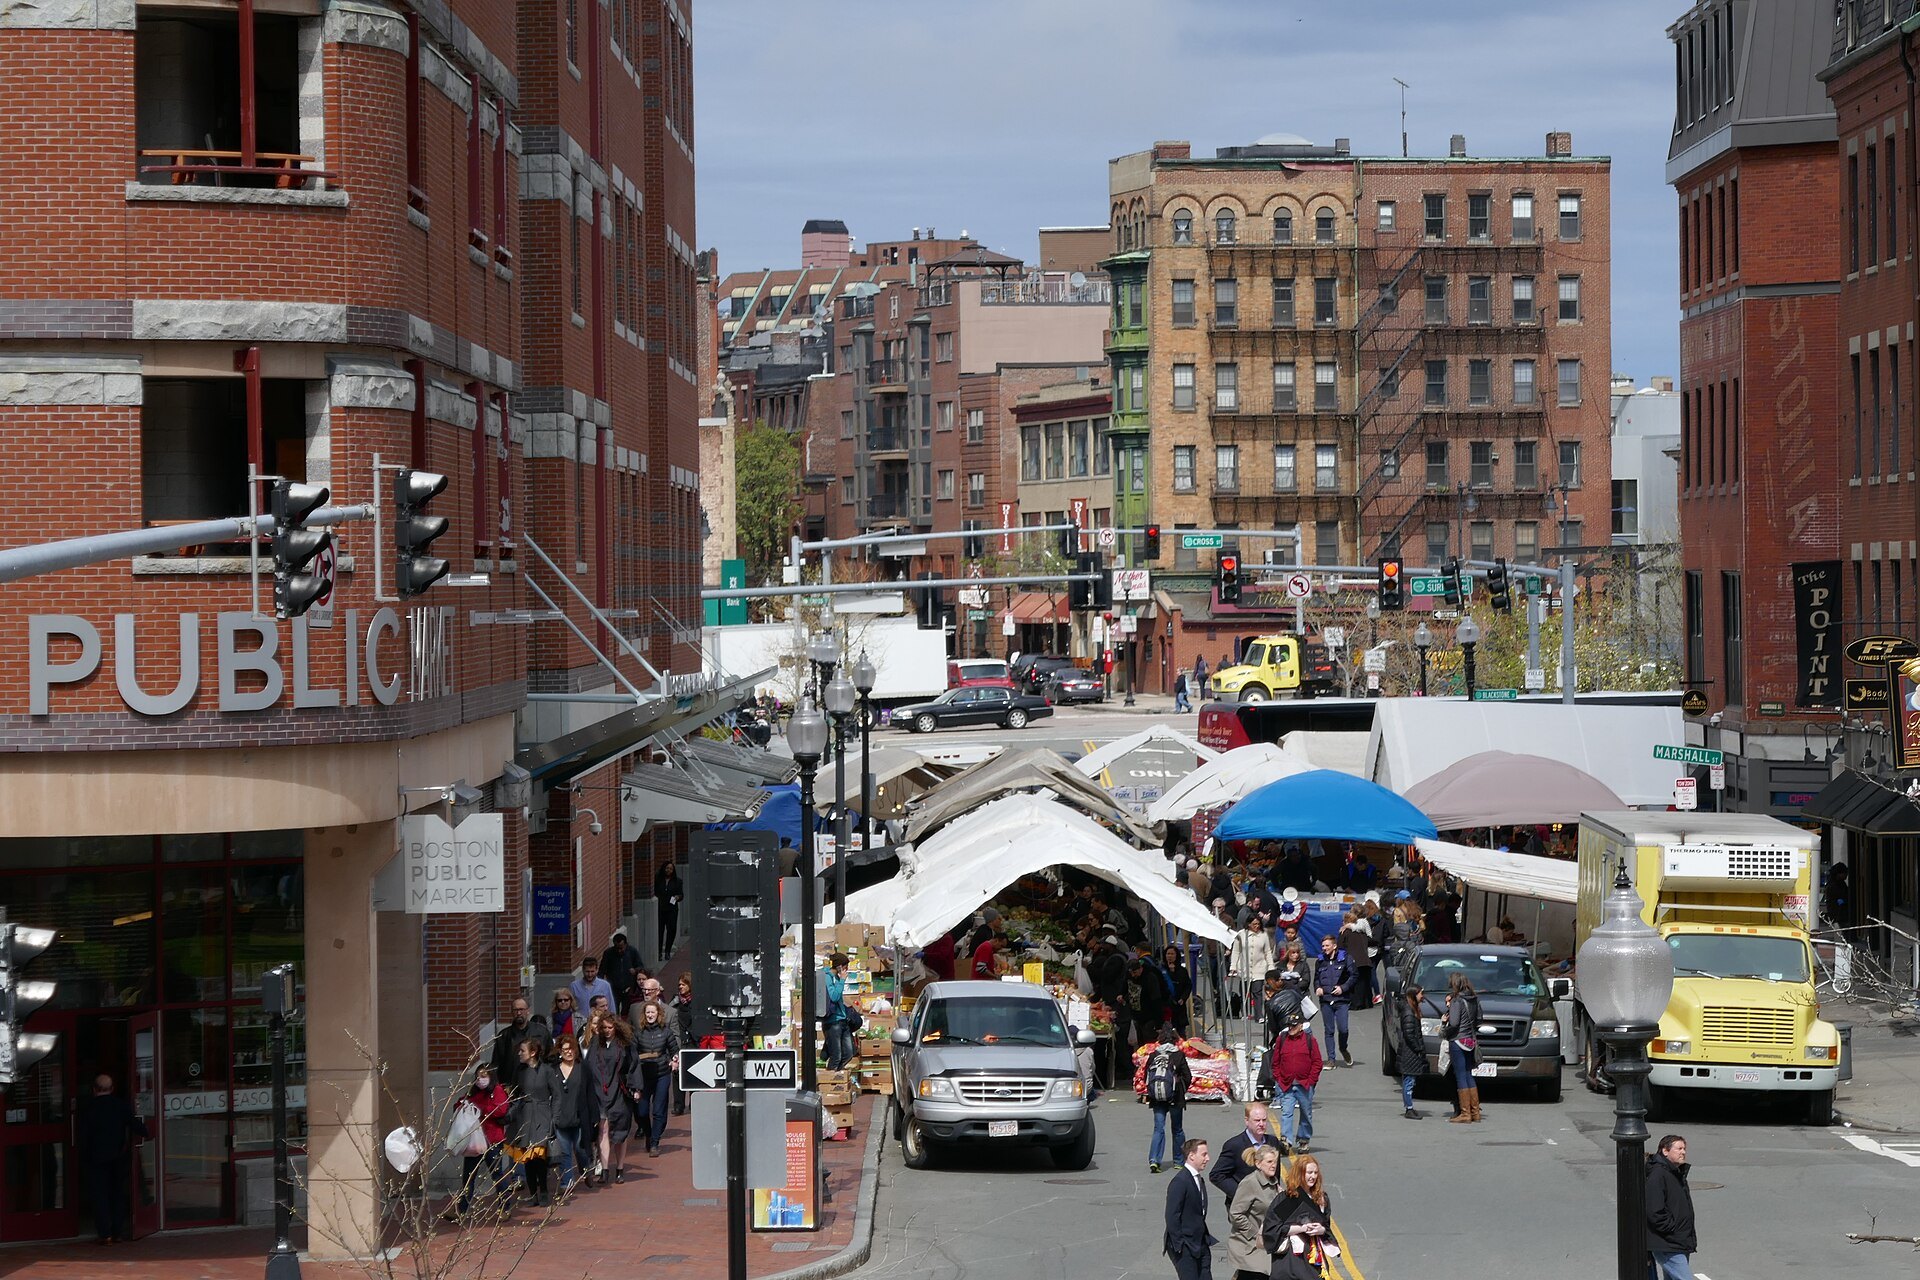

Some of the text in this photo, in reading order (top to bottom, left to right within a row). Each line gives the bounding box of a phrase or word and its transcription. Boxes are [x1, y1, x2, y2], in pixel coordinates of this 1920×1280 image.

[1193, 537, 1214, 546] CROSS
[1798, 570, 1827, 586] The
[726, 598, 740, 606] Bank
[1809, 588, 1832, 696] POINT
[1862, 641, 1902, 654] FT
[29, 607, 402, 716] PUBLIC
[1482, 690, 1510, 699] BLACKSTONE
[1867, 690, 1887, 699] Body
[1656, 745, 1710, 763] MARSHALL
[411, 841, 499, 859] BOSTON
[411, 865, 488, 882] PUBLIC
[411, 888, 499, 905] MARKET
[537, 890, 565, 898] Registry
[754, 1063, 787, 1078] WAY
[218, 1090, 299, 1108] SEASOAL
